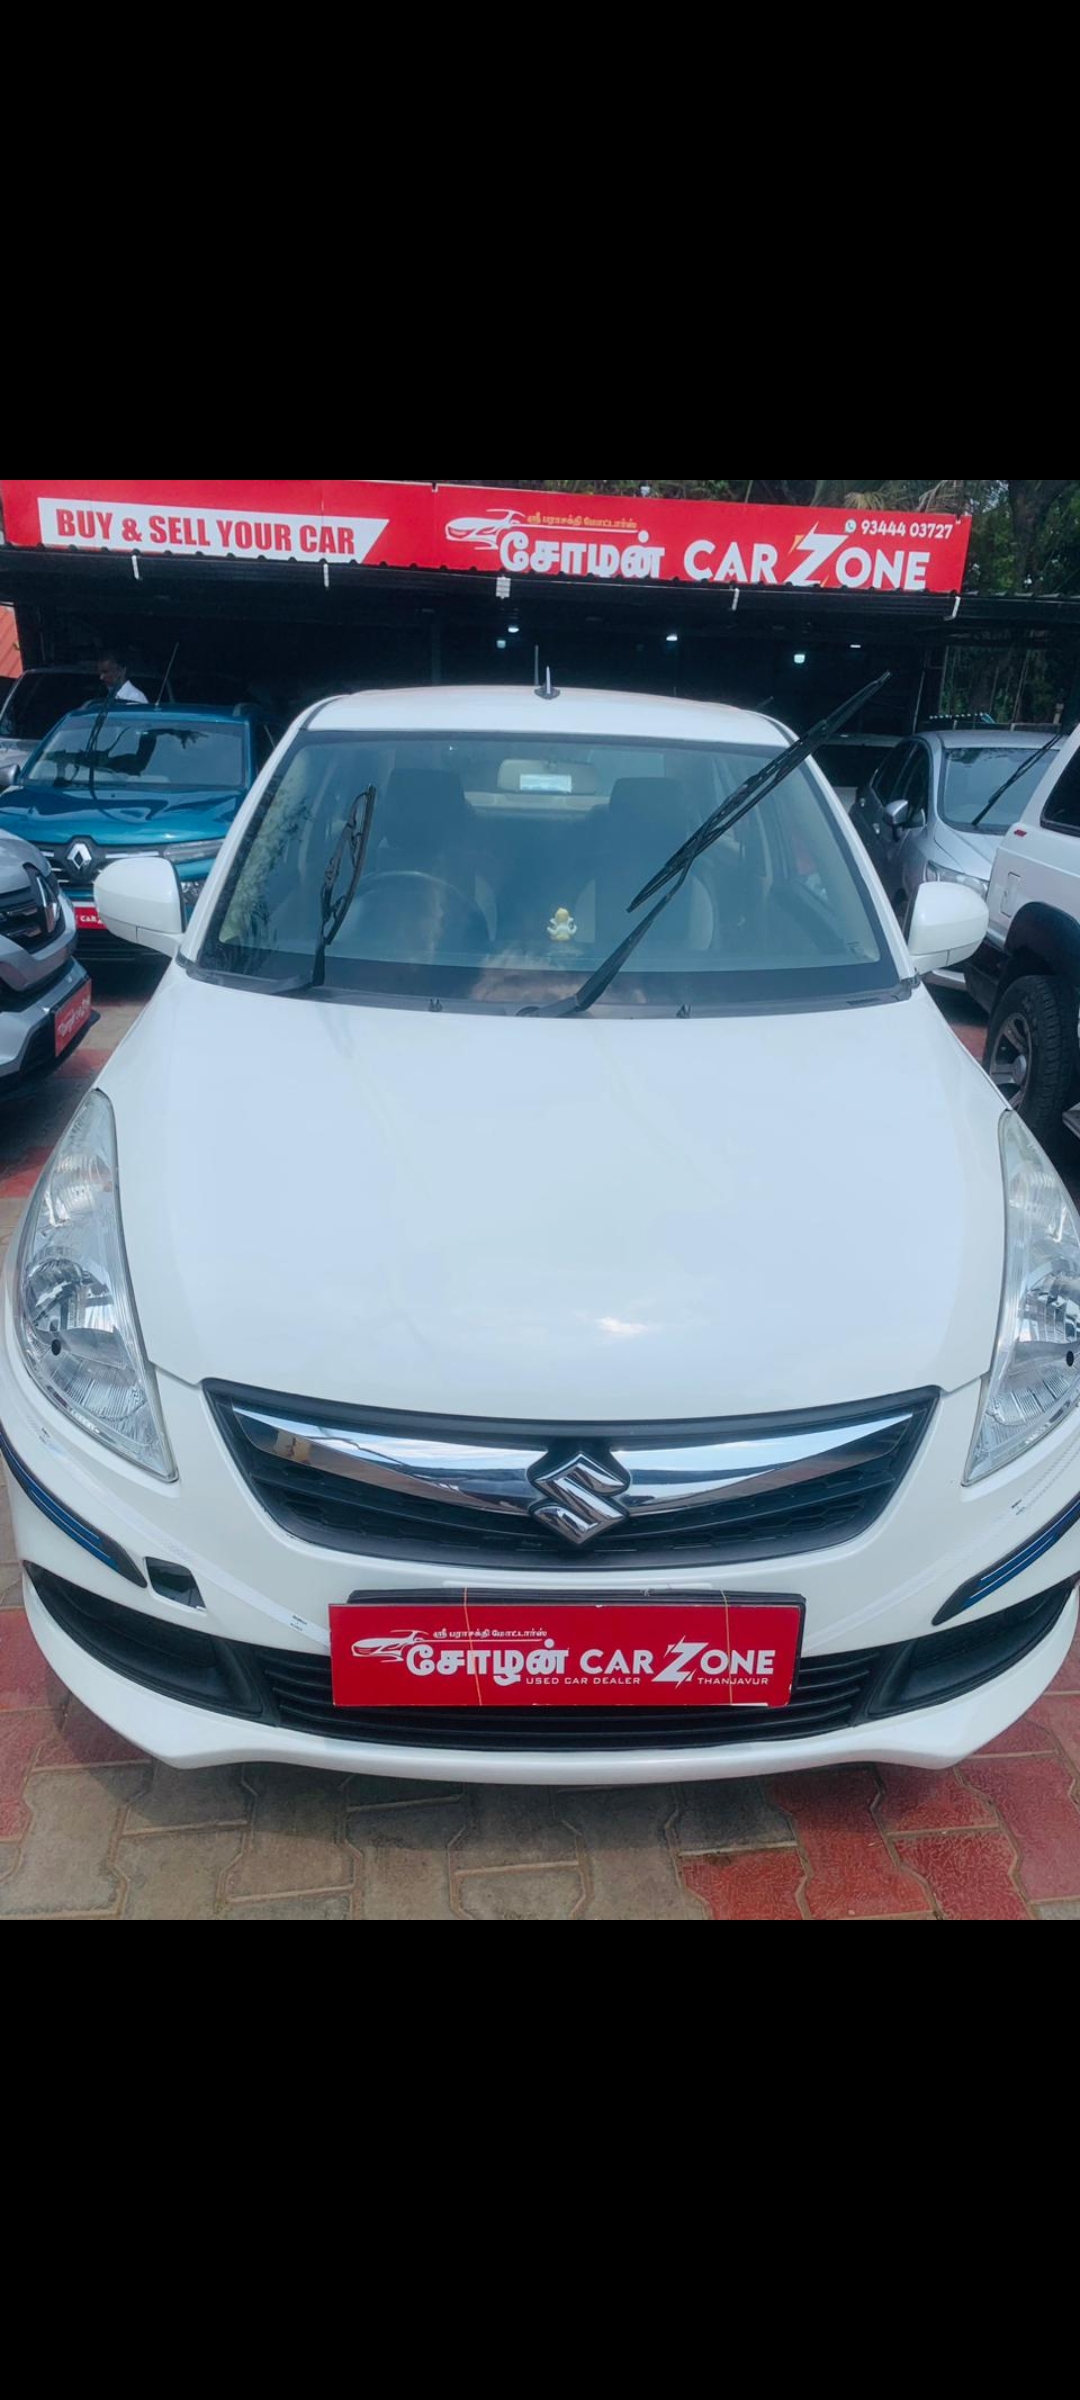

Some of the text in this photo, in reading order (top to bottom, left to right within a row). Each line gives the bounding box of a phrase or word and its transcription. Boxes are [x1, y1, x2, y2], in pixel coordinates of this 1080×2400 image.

[55, 508, 355, 555] BUY & SELL YOUR CAR
[861, 520, 954, 540] 93444 03727
[683, 539, 778, 585] CAR
[782, 522, 931, 591] ZONE
[406, 1635, 777, 1689] சோழன் CAR ZONE
[526, 1676, 770, 1686] USED CAR DEALER THANJAVUR
